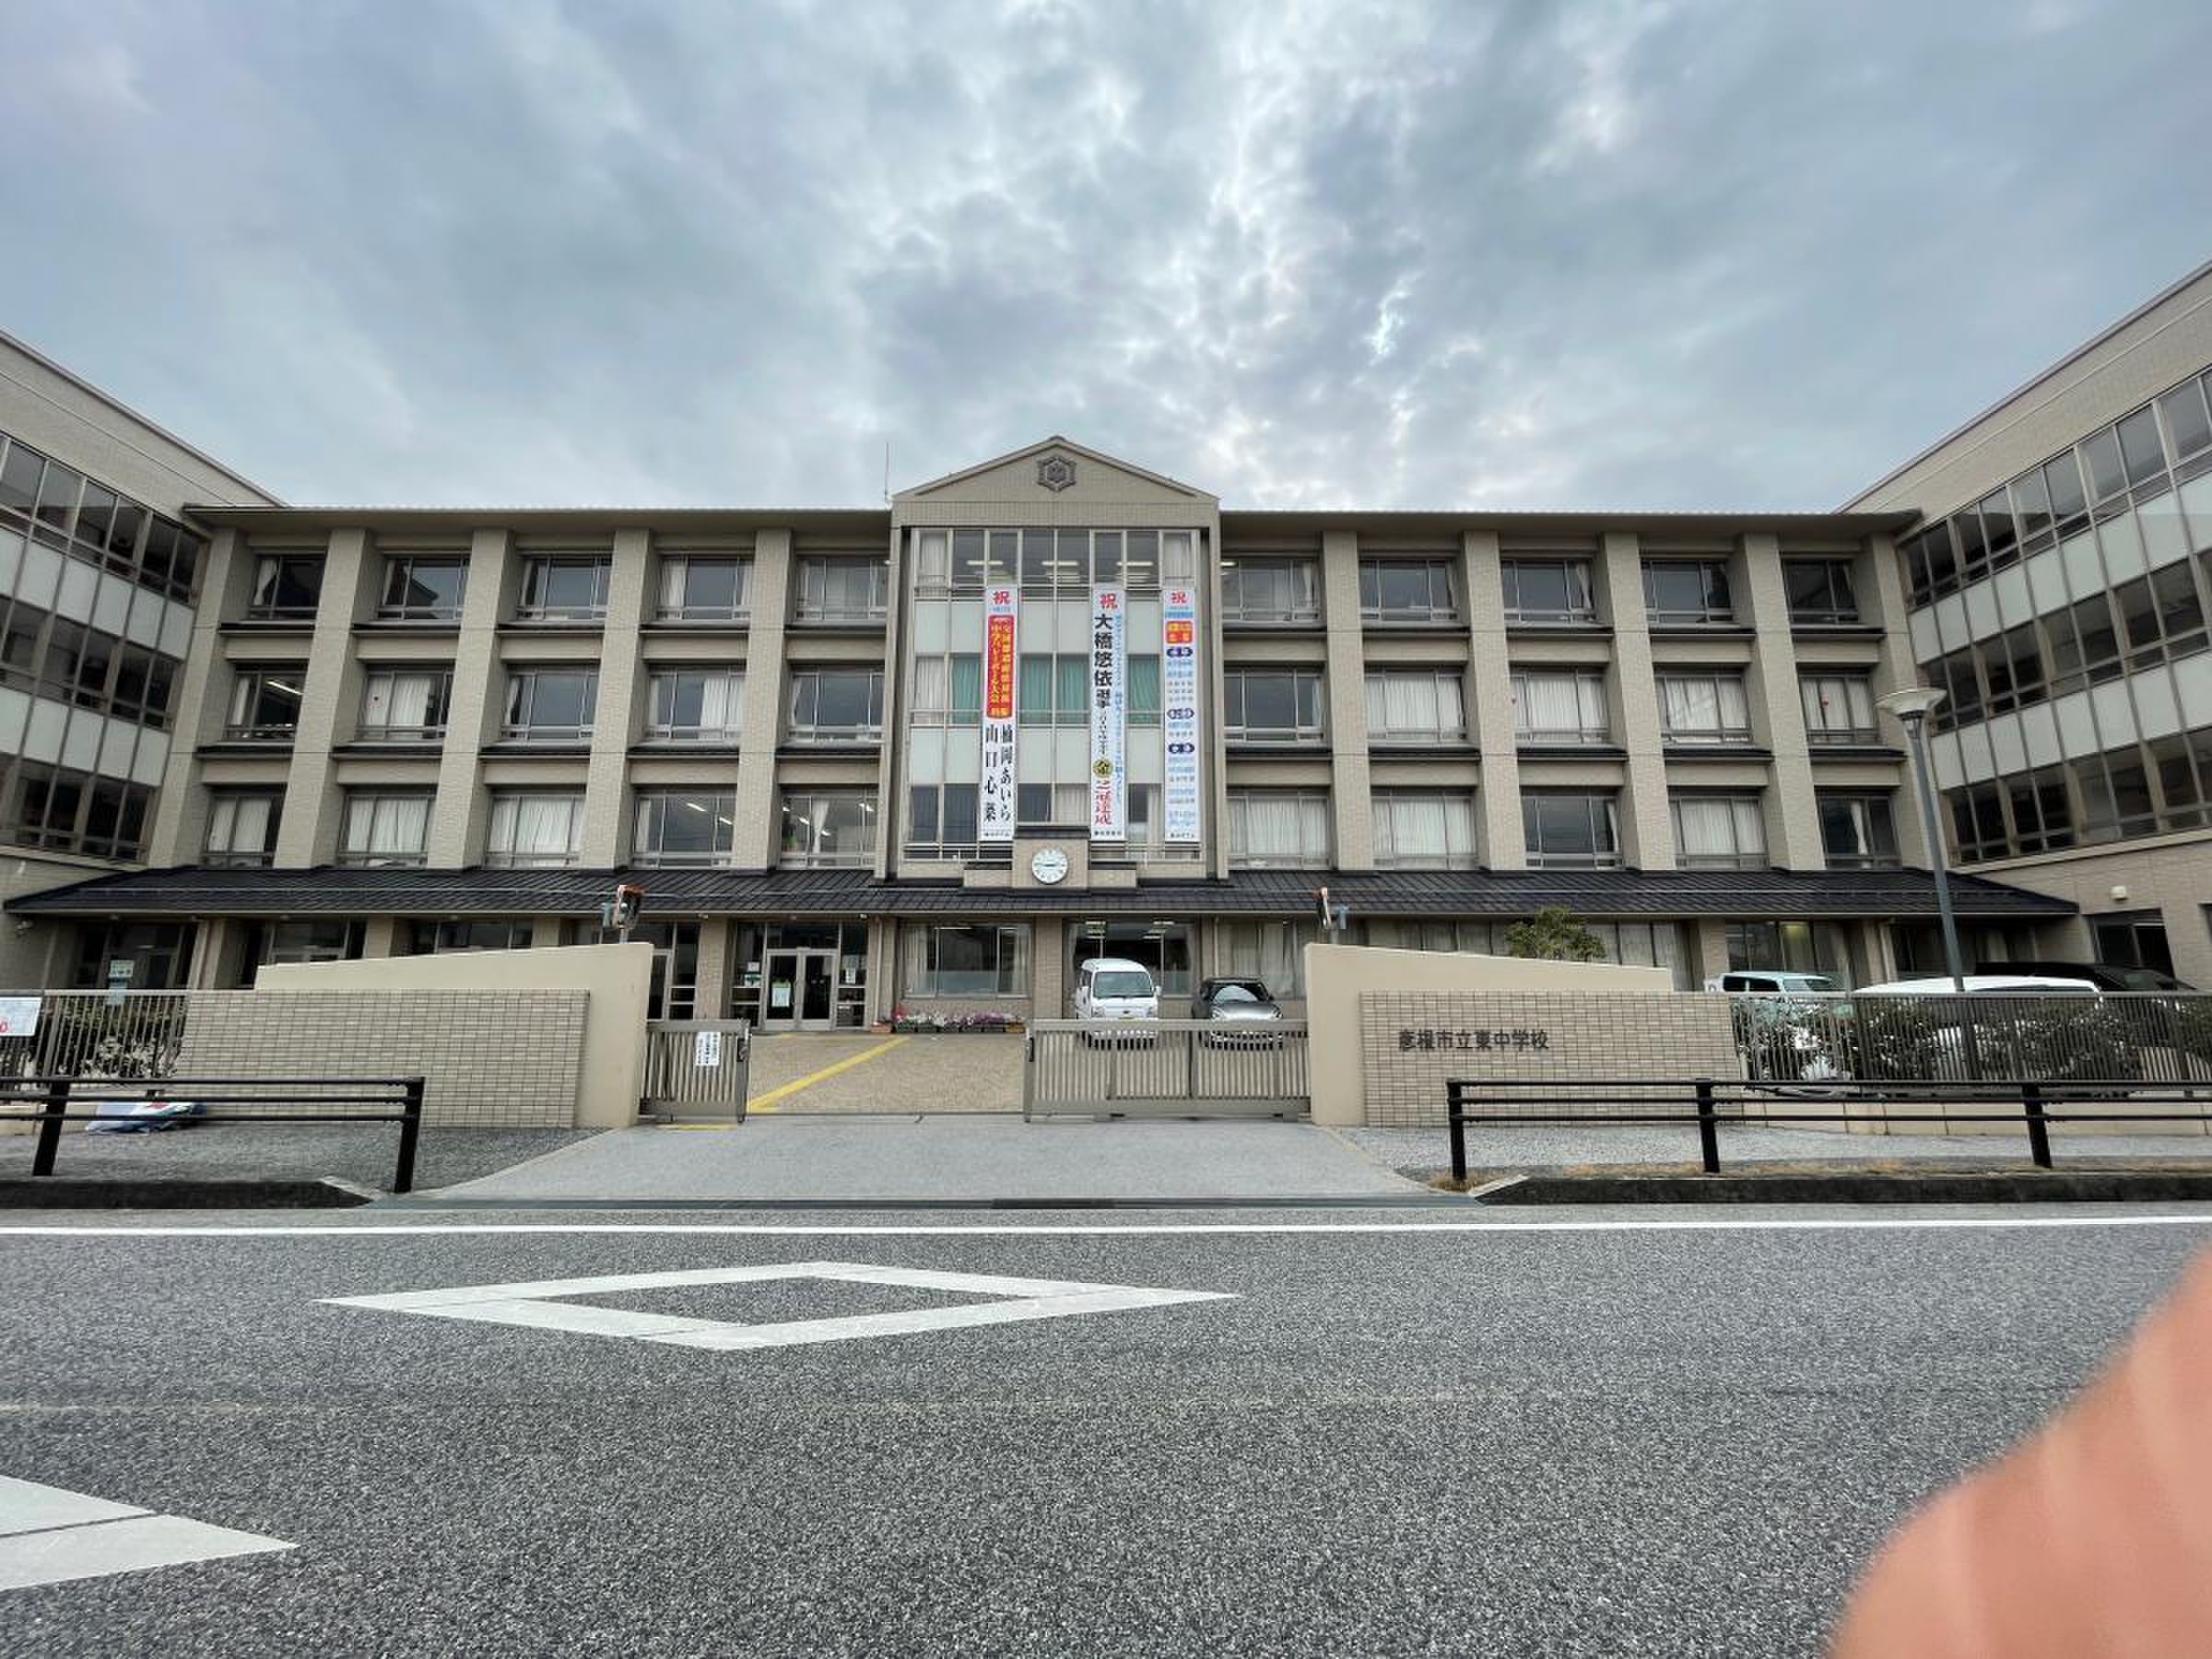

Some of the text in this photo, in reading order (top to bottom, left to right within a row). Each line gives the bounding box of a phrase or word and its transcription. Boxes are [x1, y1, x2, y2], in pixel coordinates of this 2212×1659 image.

[1100, 593, 1118, 609] 祝
[1398, 1029, 1549, 1052] 彦根市立東中学校
